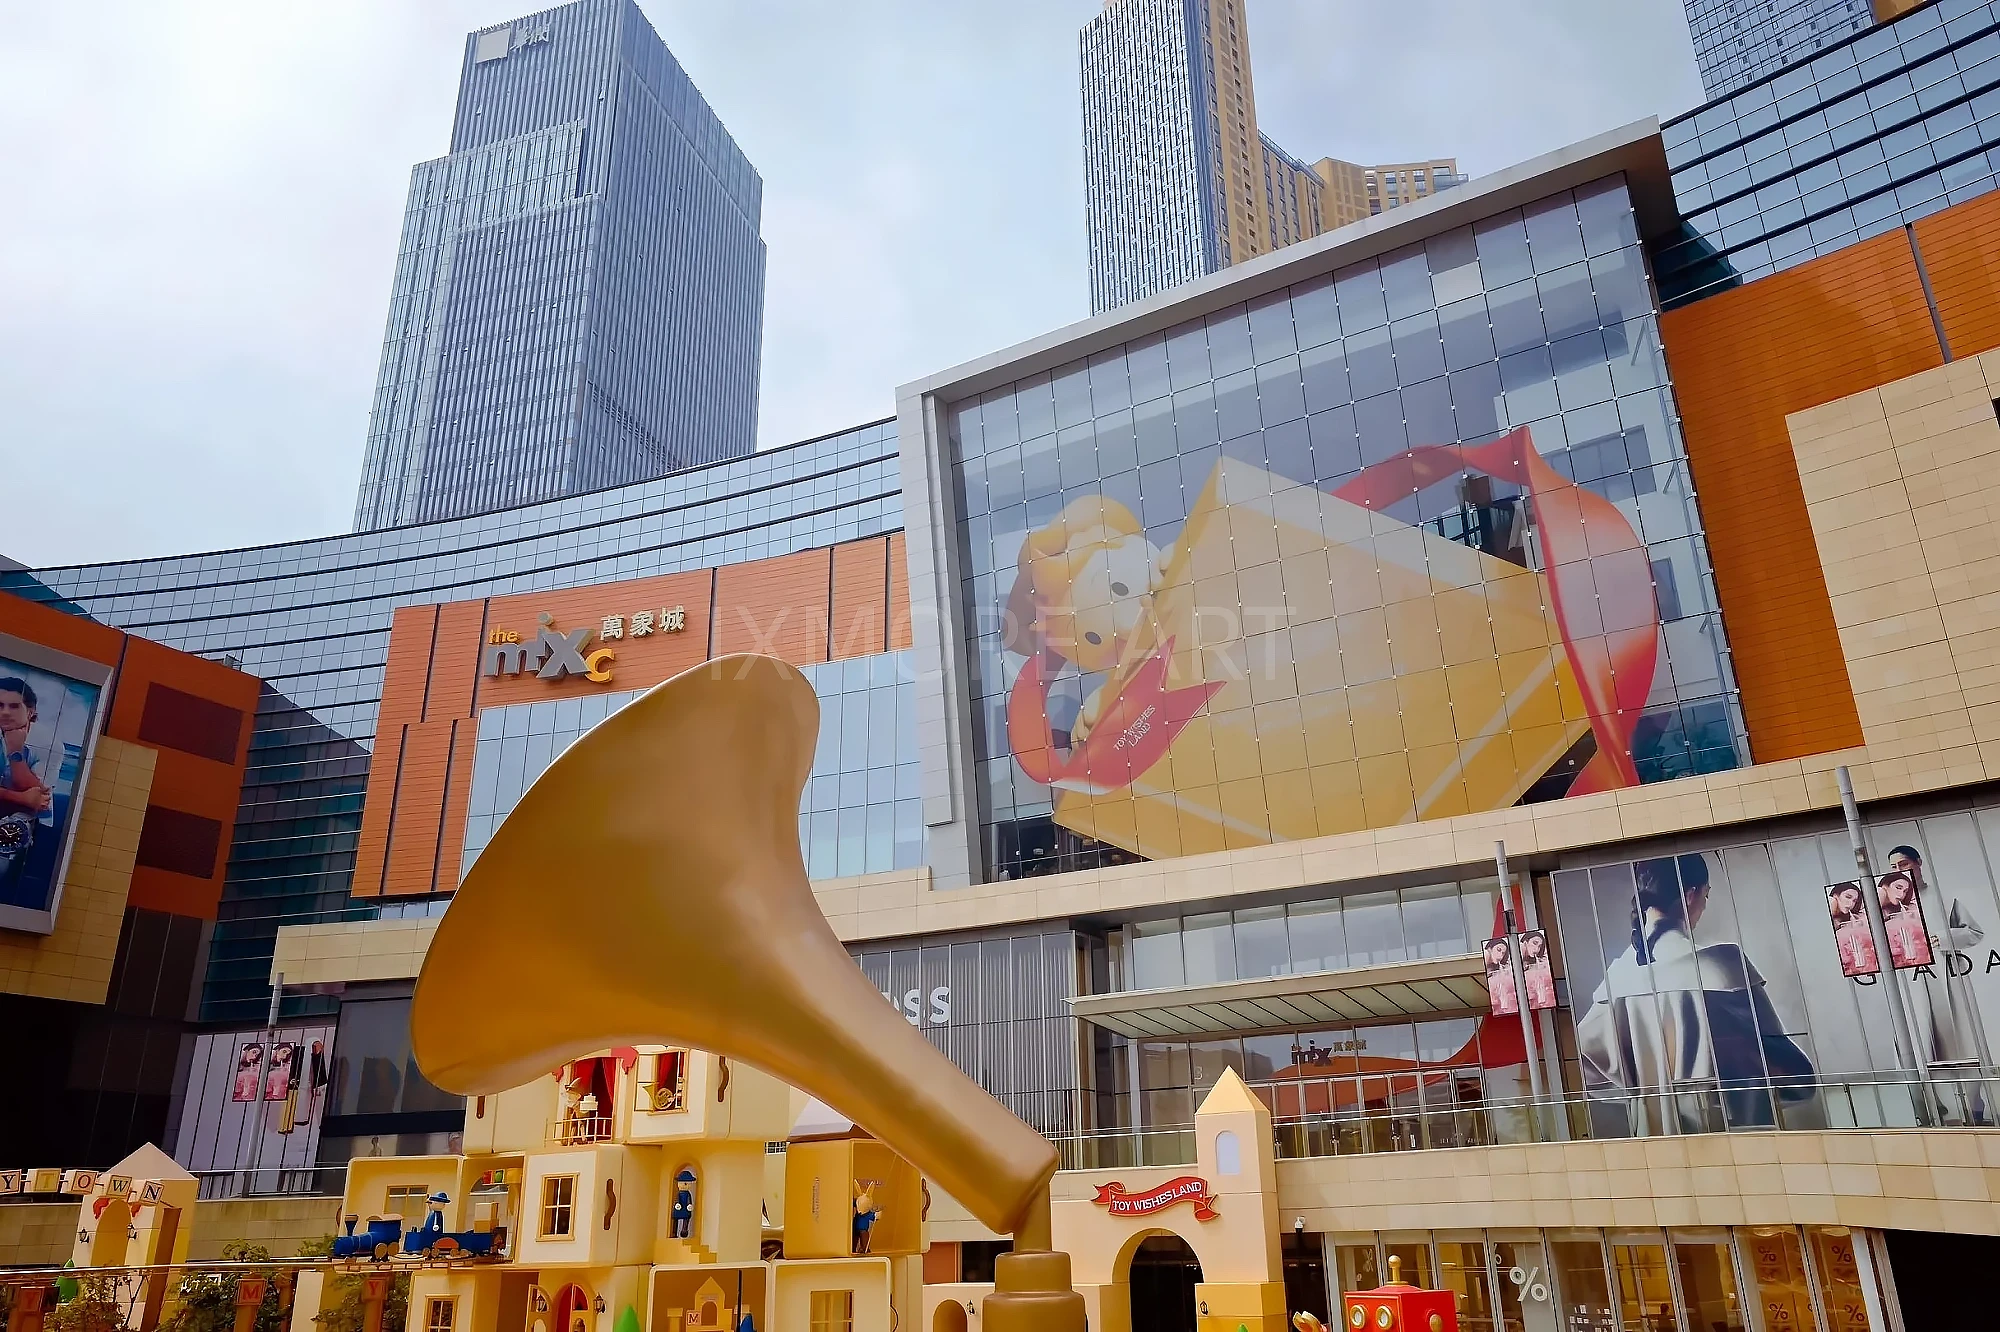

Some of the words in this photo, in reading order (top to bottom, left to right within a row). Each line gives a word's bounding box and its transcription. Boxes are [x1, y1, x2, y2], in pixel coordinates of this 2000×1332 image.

[488, 624, 520, 645] the
[600, 604, 686, 641] 萬象城
[1113, 734, 1128, 751] TOY
[1127, 704, 1156, 736] WISHES
[1128, 722, 1151, 747] LAND
[1113, 1199, 1132, 1211] TOY
[1133, 1190, 1172, 1211] WISHES
[1172, 1181, 1202, 1199] LAND
